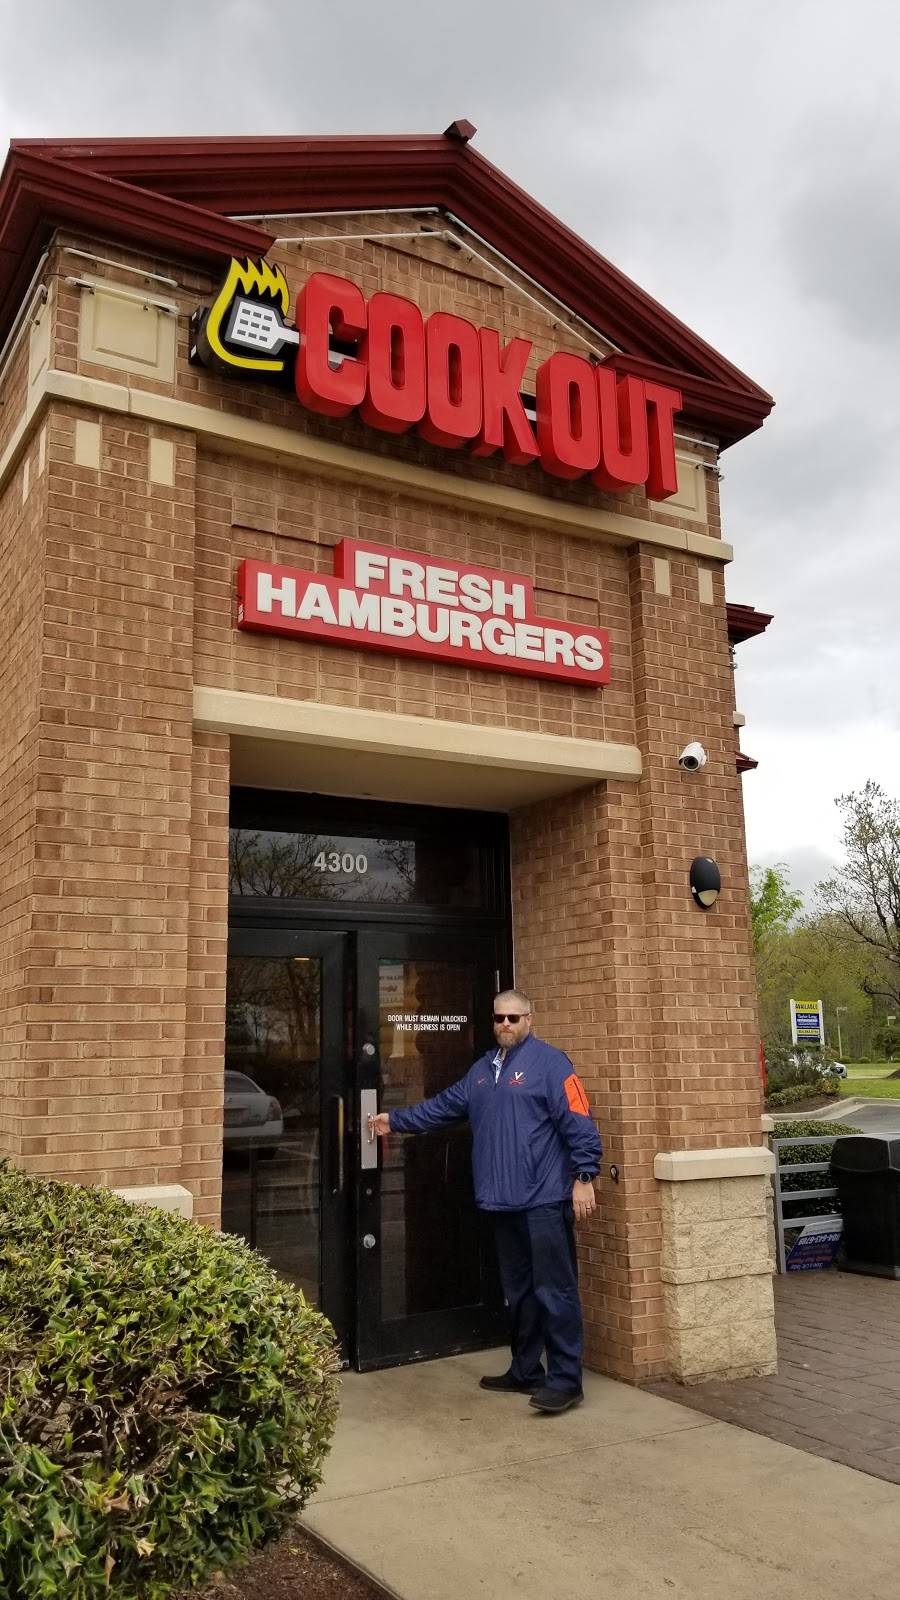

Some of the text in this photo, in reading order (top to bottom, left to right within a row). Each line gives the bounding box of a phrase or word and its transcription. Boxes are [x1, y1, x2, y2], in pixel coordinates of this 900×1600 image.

[296, 271, 683, 500] COOK OUT
[354, 549, 526, 619] FRESH
[256, 572, 604, 671] HAMBURGERS
[314, 851, 368, 873] 4300
[387, 1014, 403, 1022] DOOR
[404, 1014, 419, 1022] MUST
[440, 1015, 468, 1023] UNLOCKED
[396, 1023, 461, 1031] WHILE BUSINESS IS OPEN
